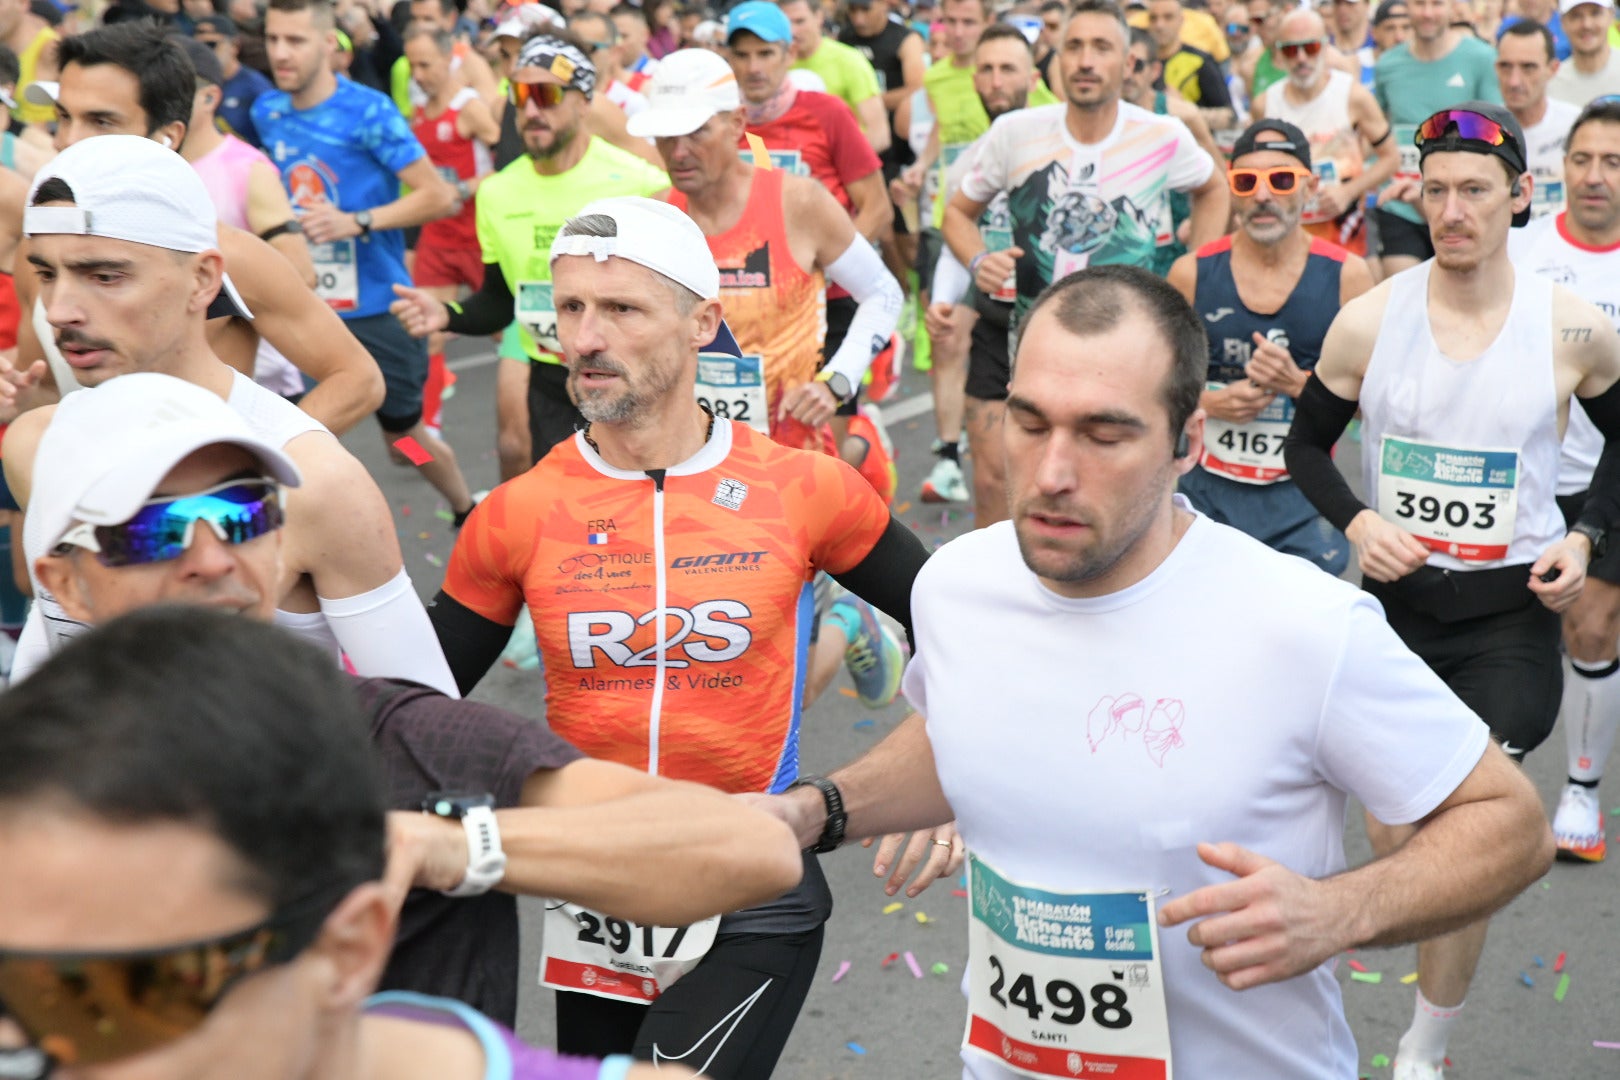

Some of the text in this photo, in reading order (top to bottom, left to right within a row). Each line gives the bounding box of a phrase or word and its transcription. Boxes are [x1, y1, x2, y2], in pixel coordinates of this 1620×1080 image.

[1561, 328, 1592, 342] 777
[698, 397, 750, 420] 82
[1218, 429, 1286, 456] 4167
[1395, 491, 1496, 529] 3903
[588, 519, 616, 532] FRA
[670, 551, 769, 569] GIANT
[684, 564, 761, 576] VALENCIENNES
[574, 570, 593, 580] des
[594, 567, 604, 579] 4
[567, 599, 753, 668] R2S
[577, 671, 743, 692] Alarmes & Vidéo
[1027, 899, 1092, 919] MARATÓN
[575, 911, 691, 958] 2917
[1014, 912, 1062, 935] Elche
[1063, 925, 1093, 937] 42K
[1015, 925, 1095, 951] Alicante
[989, 954, 1133, 1029] 2498
[1031, 1030, 1068, 1044] SANTI
